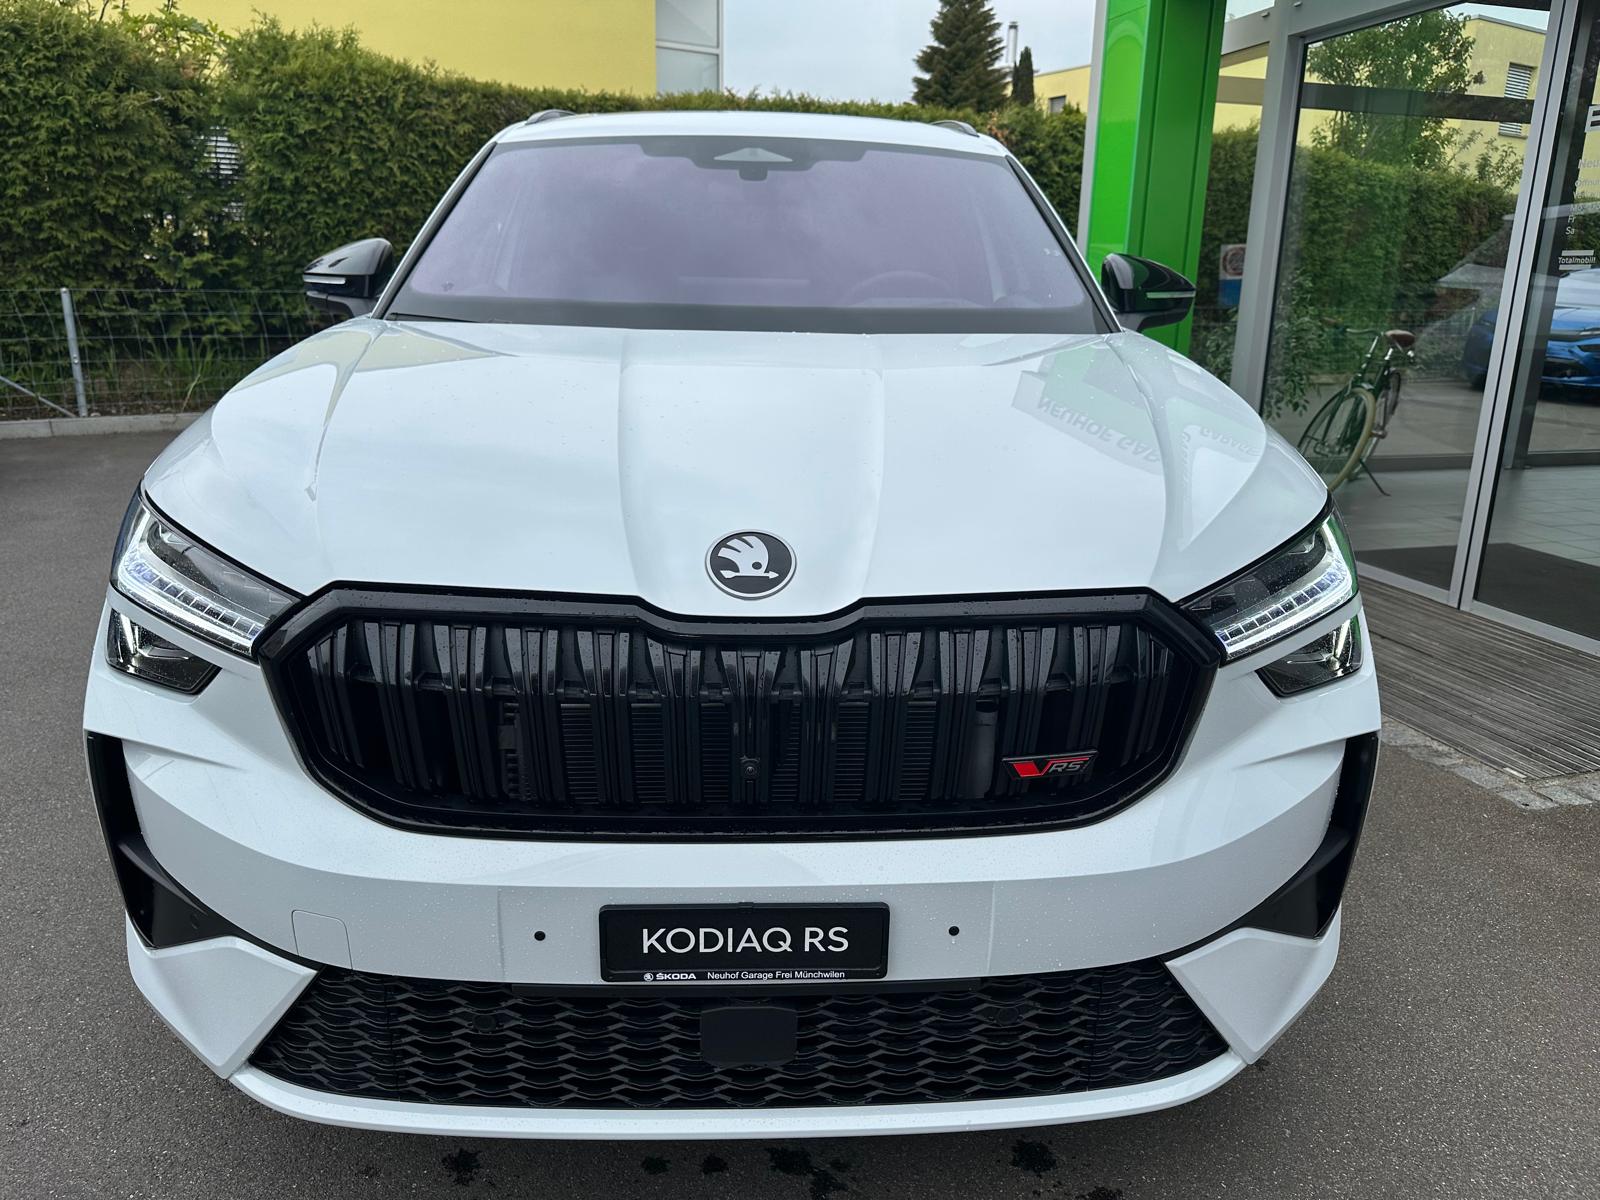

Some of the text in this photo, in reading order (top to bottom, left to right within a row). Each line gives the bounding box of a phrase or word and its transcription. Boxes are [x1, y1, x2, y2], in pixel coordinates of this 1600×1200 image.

[1565, 226, 1575, 235] Sa
[642, 926, 849, 954] KODIAQ RS
[656, 970, 845, 981] ŠKODA Neuhof Garage Frei Münchwilen
